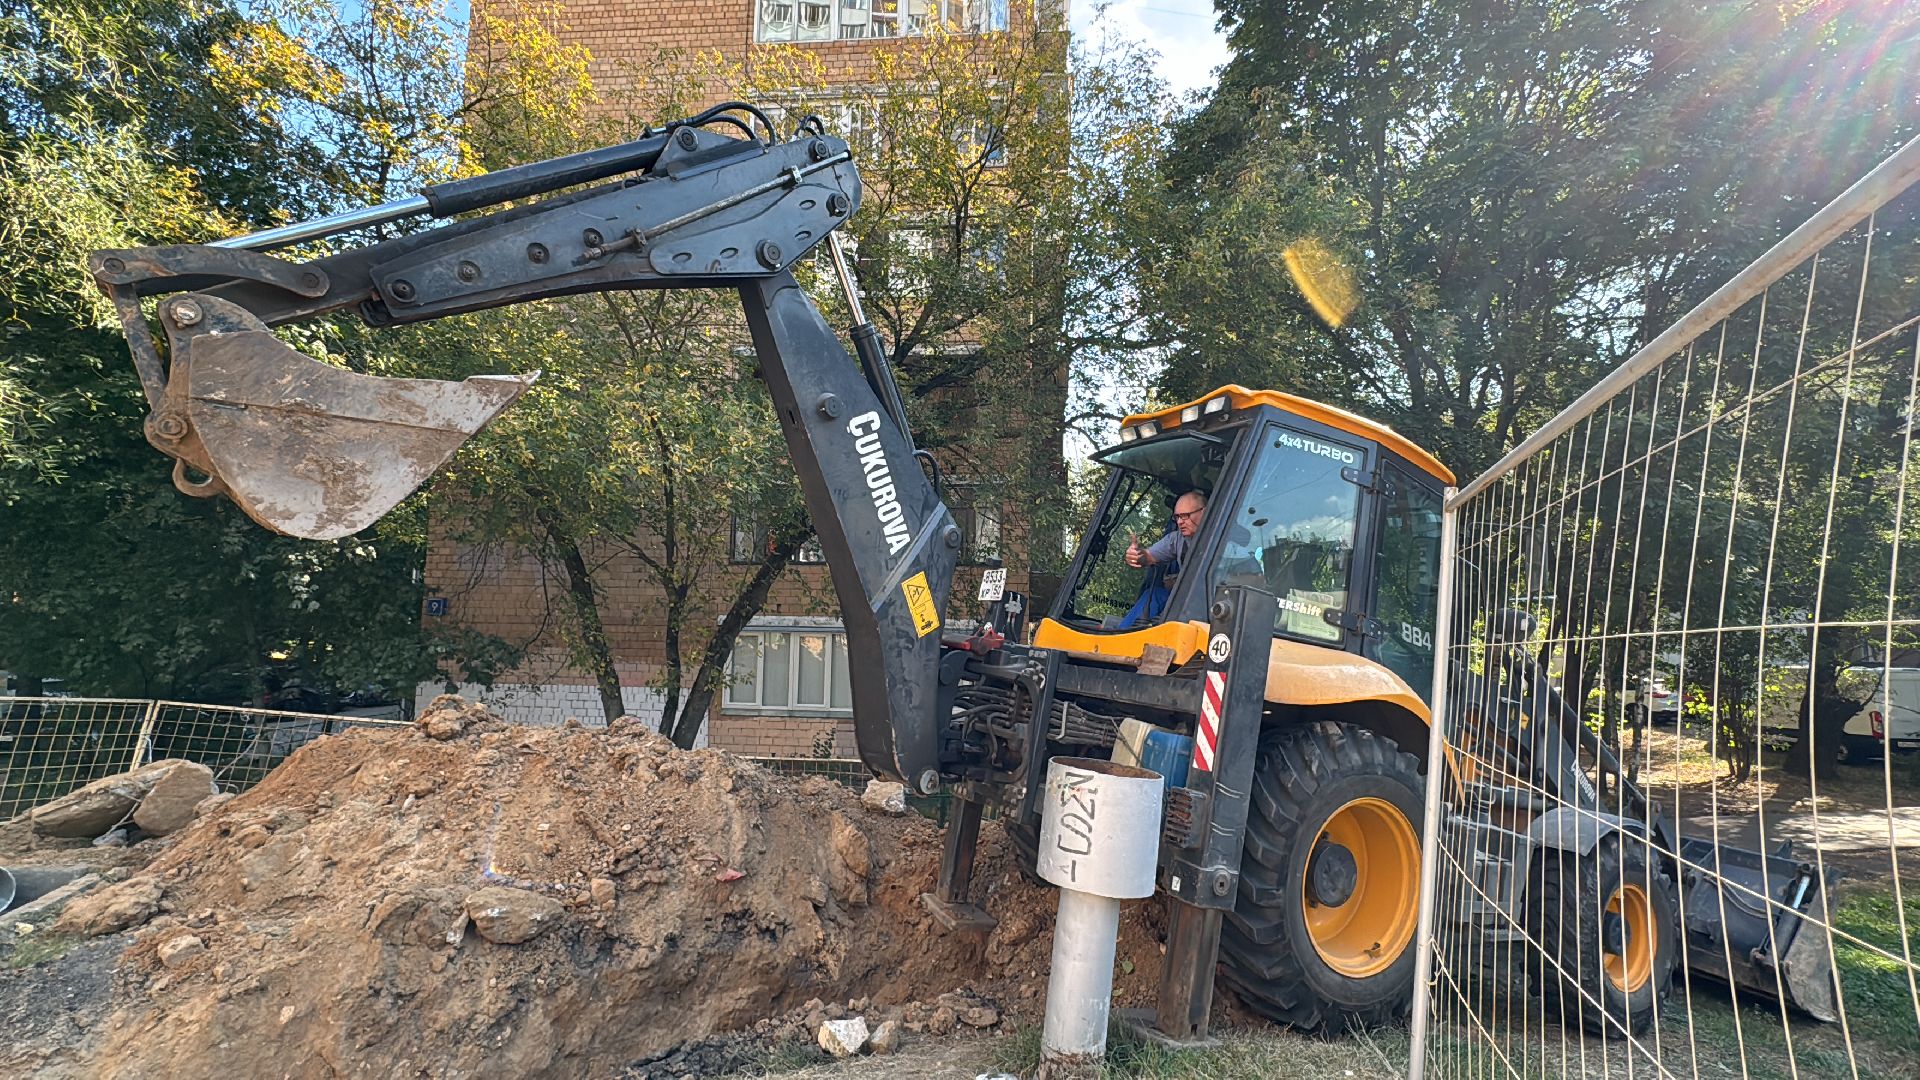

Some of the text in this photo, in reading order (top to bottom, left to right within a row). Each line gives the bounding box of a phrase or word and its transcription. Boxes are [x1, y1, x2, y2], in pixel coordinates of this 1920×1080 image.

[847, 410, 911, 556] ÇUKUROVA
[1211, 639, 1228, 657] 40
[1401, 621, 1432, 651] 884
